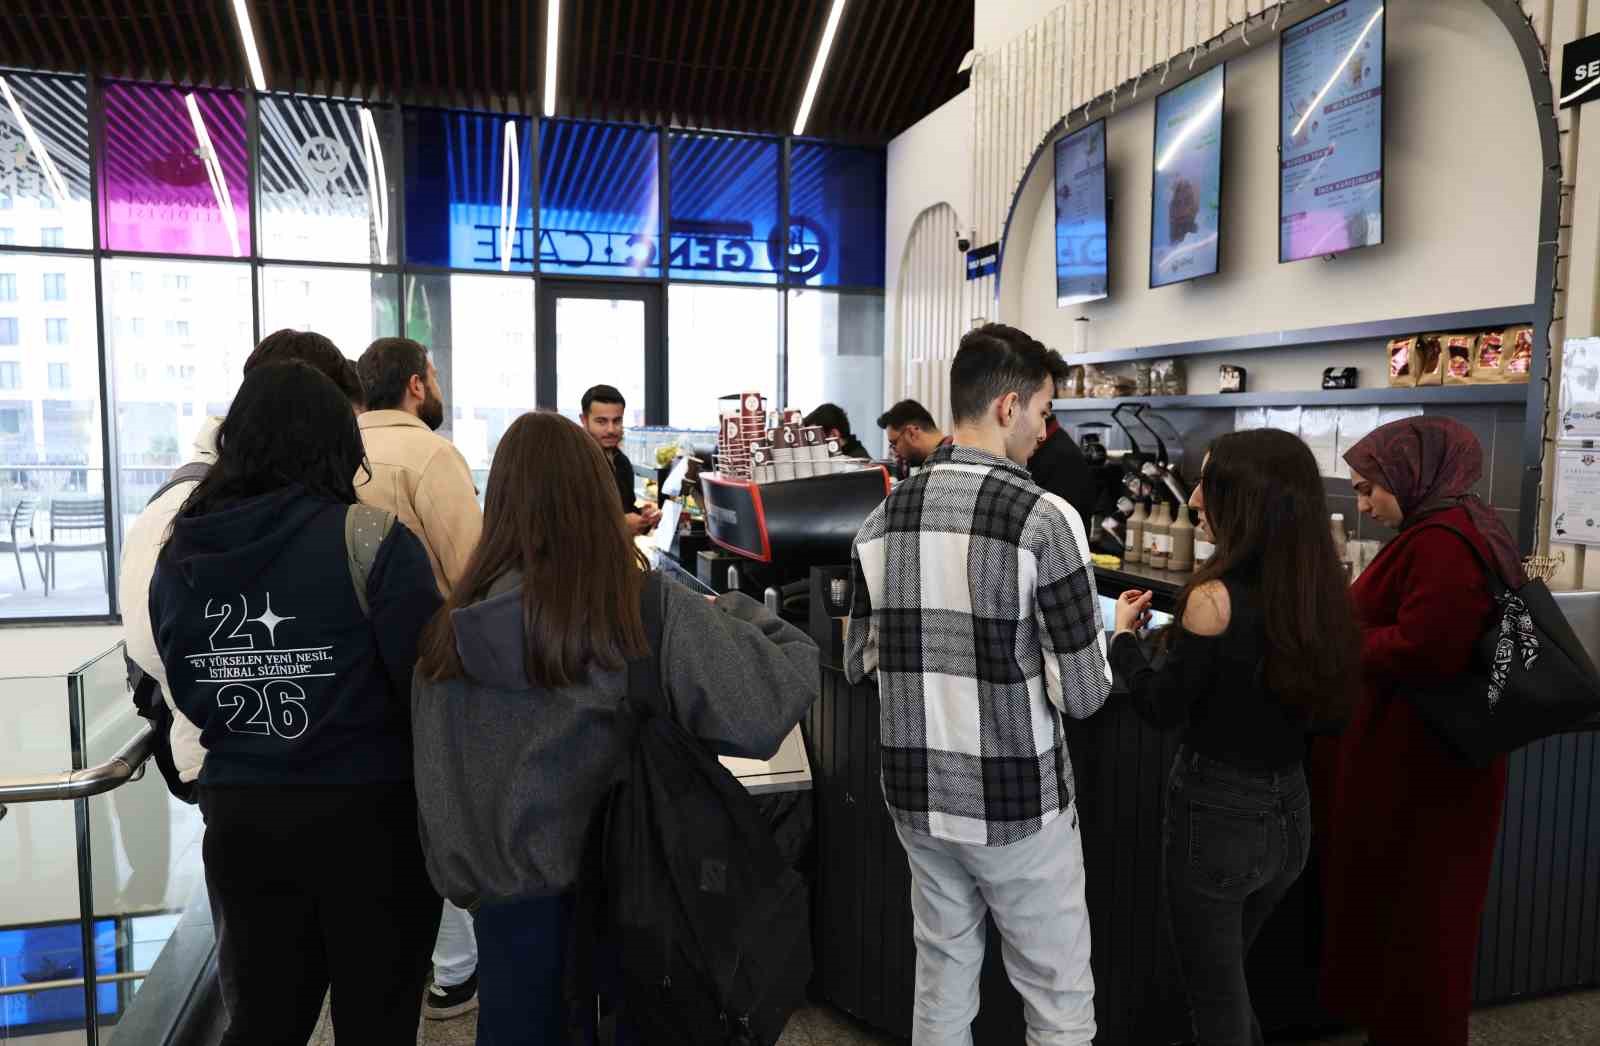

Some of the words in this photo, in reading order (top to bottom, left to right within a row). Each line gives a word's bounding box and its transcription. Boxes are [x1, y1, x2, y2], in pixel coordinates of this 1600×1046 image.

[1574, 60, 1600, 81] SE
[209, 655, 262, 667] YÜKSELEN
[265, 652, 292, 664] YENİ
[209, 666, 254, 678] İSTİKBAL
[216, 680, 309, 739] 26
